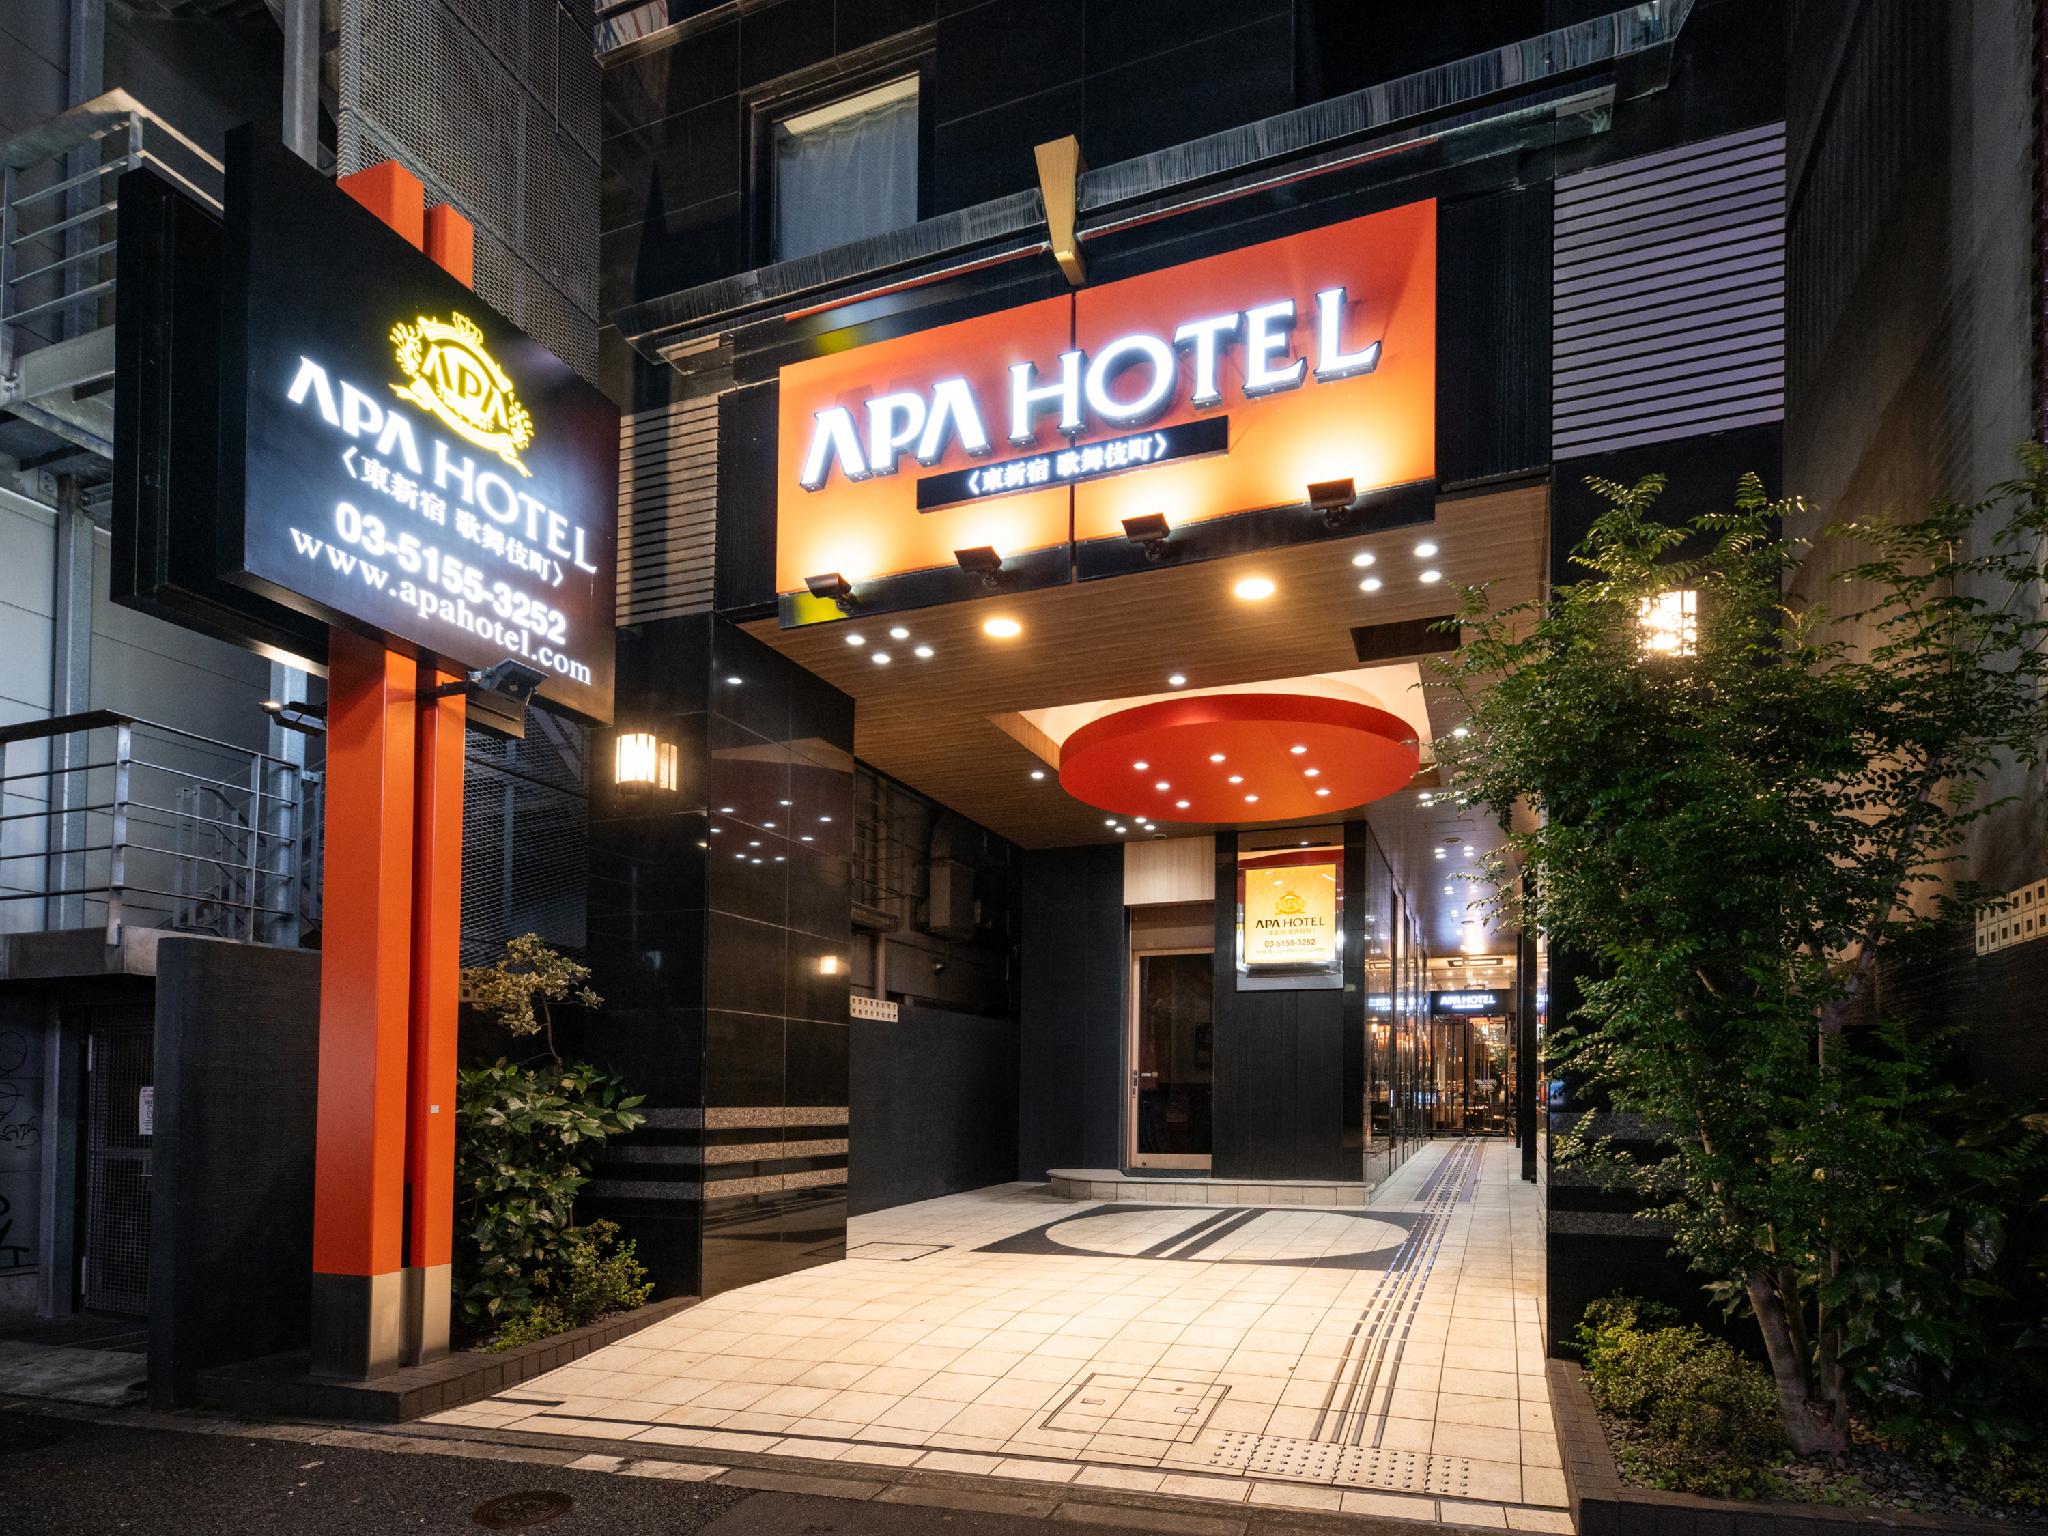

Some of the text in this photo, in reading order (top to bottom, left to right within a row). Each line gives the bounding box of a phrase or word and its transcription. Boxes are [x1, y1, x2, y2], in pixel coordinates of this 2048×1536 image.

[421, 343, 510, 430] APA
[800, 286, 1383, 492] APA HOTEL
[287, 355, 598, 574] APA HOTEL
[289, 527, 592, 686] www.apahotel.com
[335, 501, 567, 645] 03-5155-3252
[1255, 916, 1325, 929] APA HOTEL
[1264, 938, 1316, 948] 03-5155-3252
[1461, 994, 1496, 1005] HOTEL
